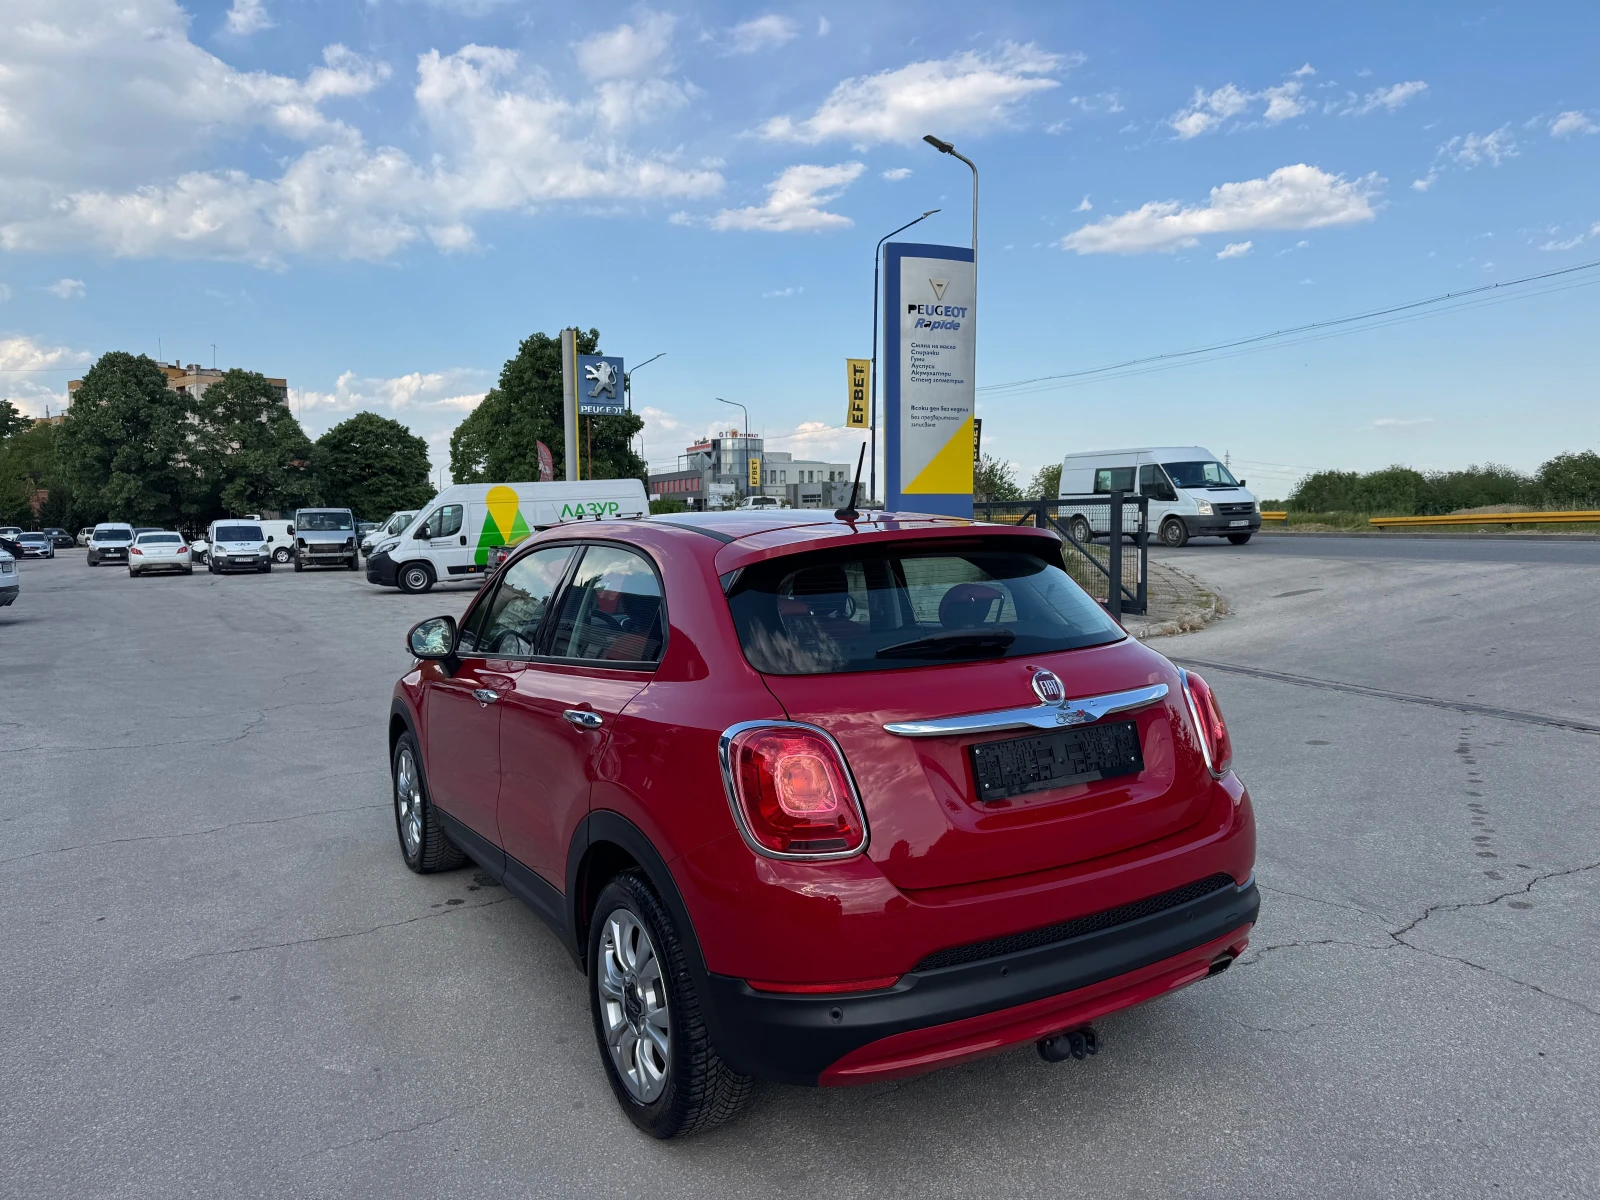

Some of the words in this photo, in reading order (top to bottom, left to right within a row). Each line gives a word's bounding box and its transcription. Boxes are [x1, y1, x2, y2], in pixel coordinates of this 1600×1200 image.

[908, 304, 967, 318] PEUGEOT
[914, 318, 961, 331] Rapide
[852, 363, 865, 424] EFBET
[580, 405, 624, 414] PEUGEOT
[561, 501, 619, 517] ЛАЗУР
[1039, 680, 1059, 696] FIAT
